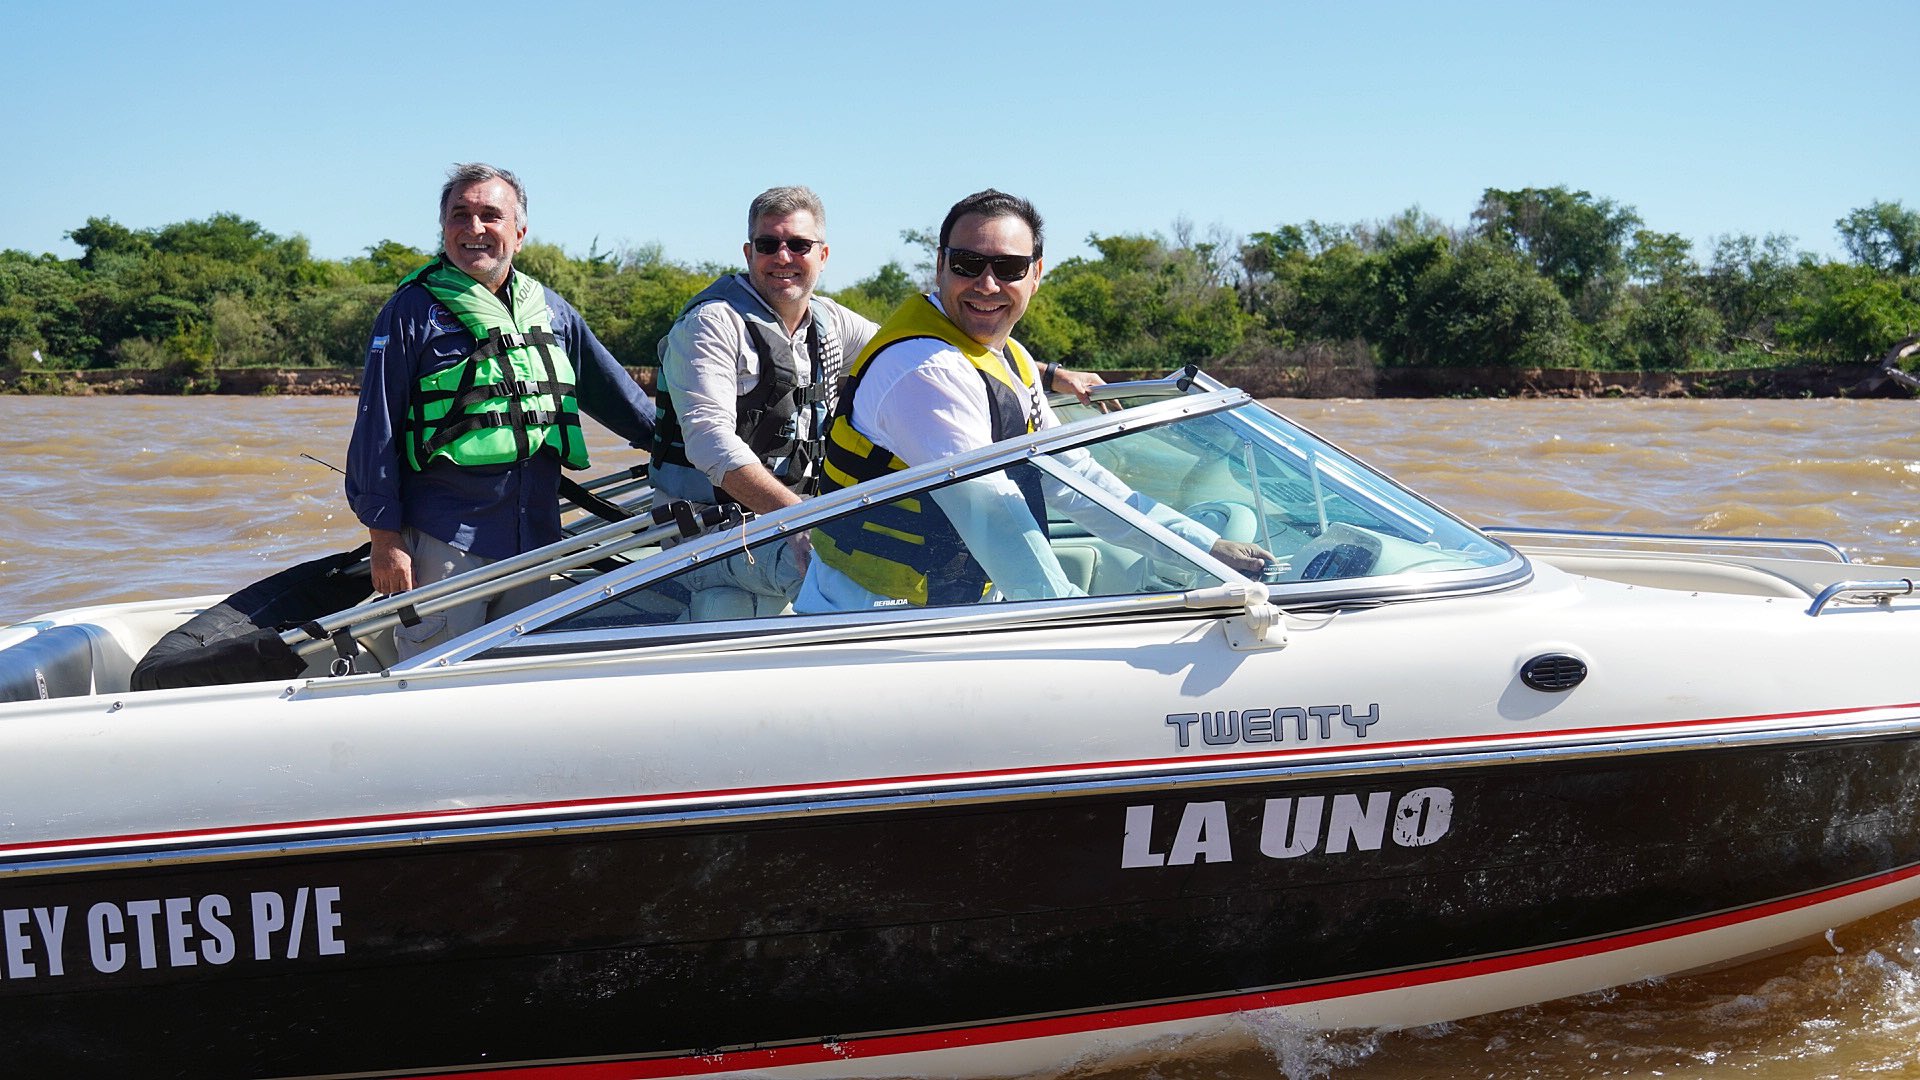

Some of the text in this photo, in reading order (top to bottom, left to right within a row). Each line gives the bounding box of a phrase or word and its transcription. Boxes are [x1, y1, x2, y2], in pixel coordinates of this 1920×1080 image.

[873, 598, 908, 607] BERMUDA
[1166, 703, 1379, 748] TWENTY
[1121, 786, 1455, 869] LA UNO
[0, 886, 346, 979] EY CTES P/E
